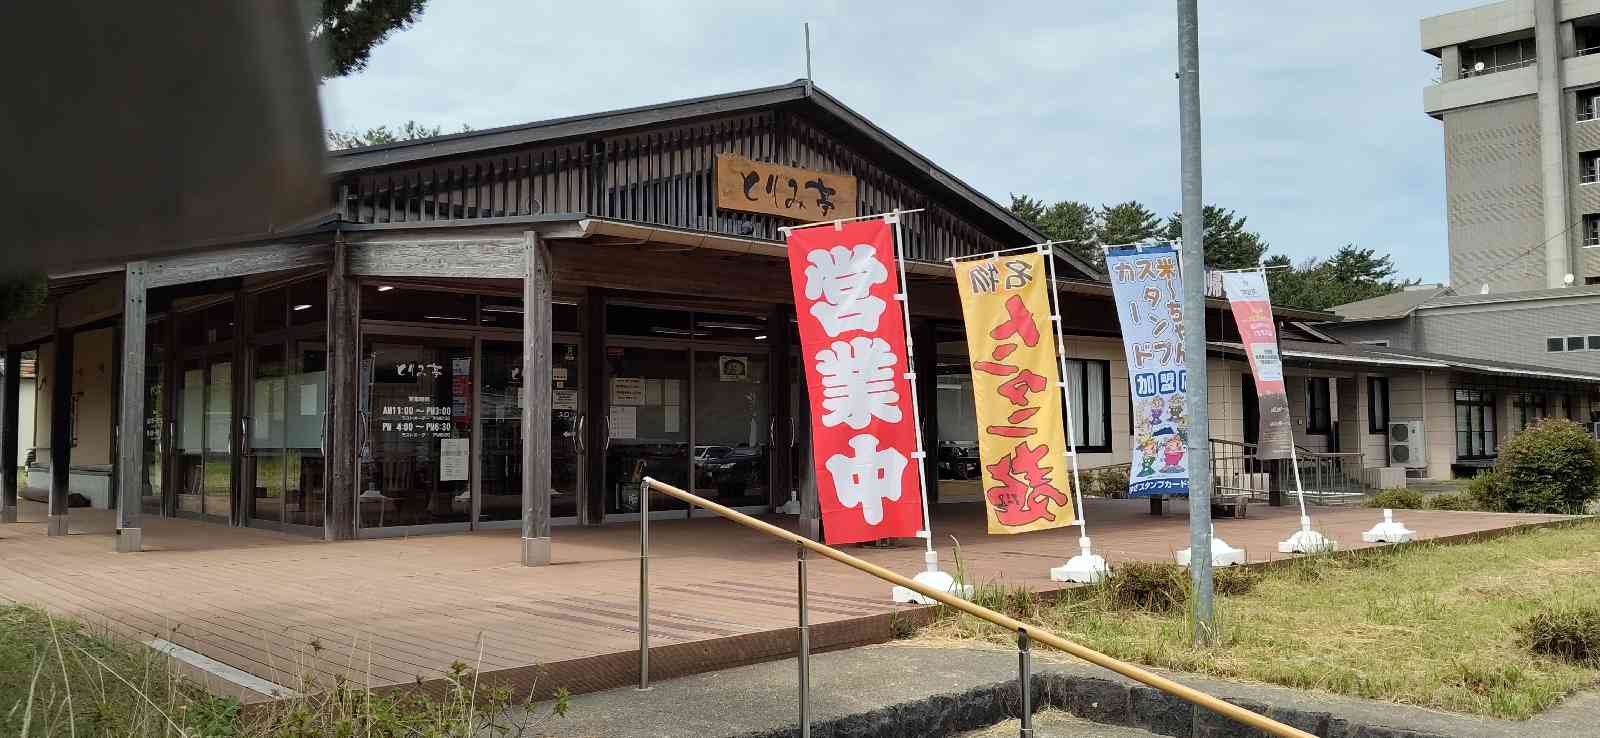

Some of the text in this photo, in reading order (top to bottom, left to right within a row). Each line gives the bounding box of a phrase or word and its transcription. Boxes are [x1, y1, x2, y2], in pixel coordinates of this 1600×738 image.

[740, 170, 836, 217] とりみ亭
[1113, 261, 1154, 368] カード
[396, 363, 443, 378] とりみ亭
[804, 244, 908, 526] 営業中
[382, 406, 414, 415] AM11:00
[426, 406, 451, 415] PM3:00
[426, 423, 451, 431] PM6:30
